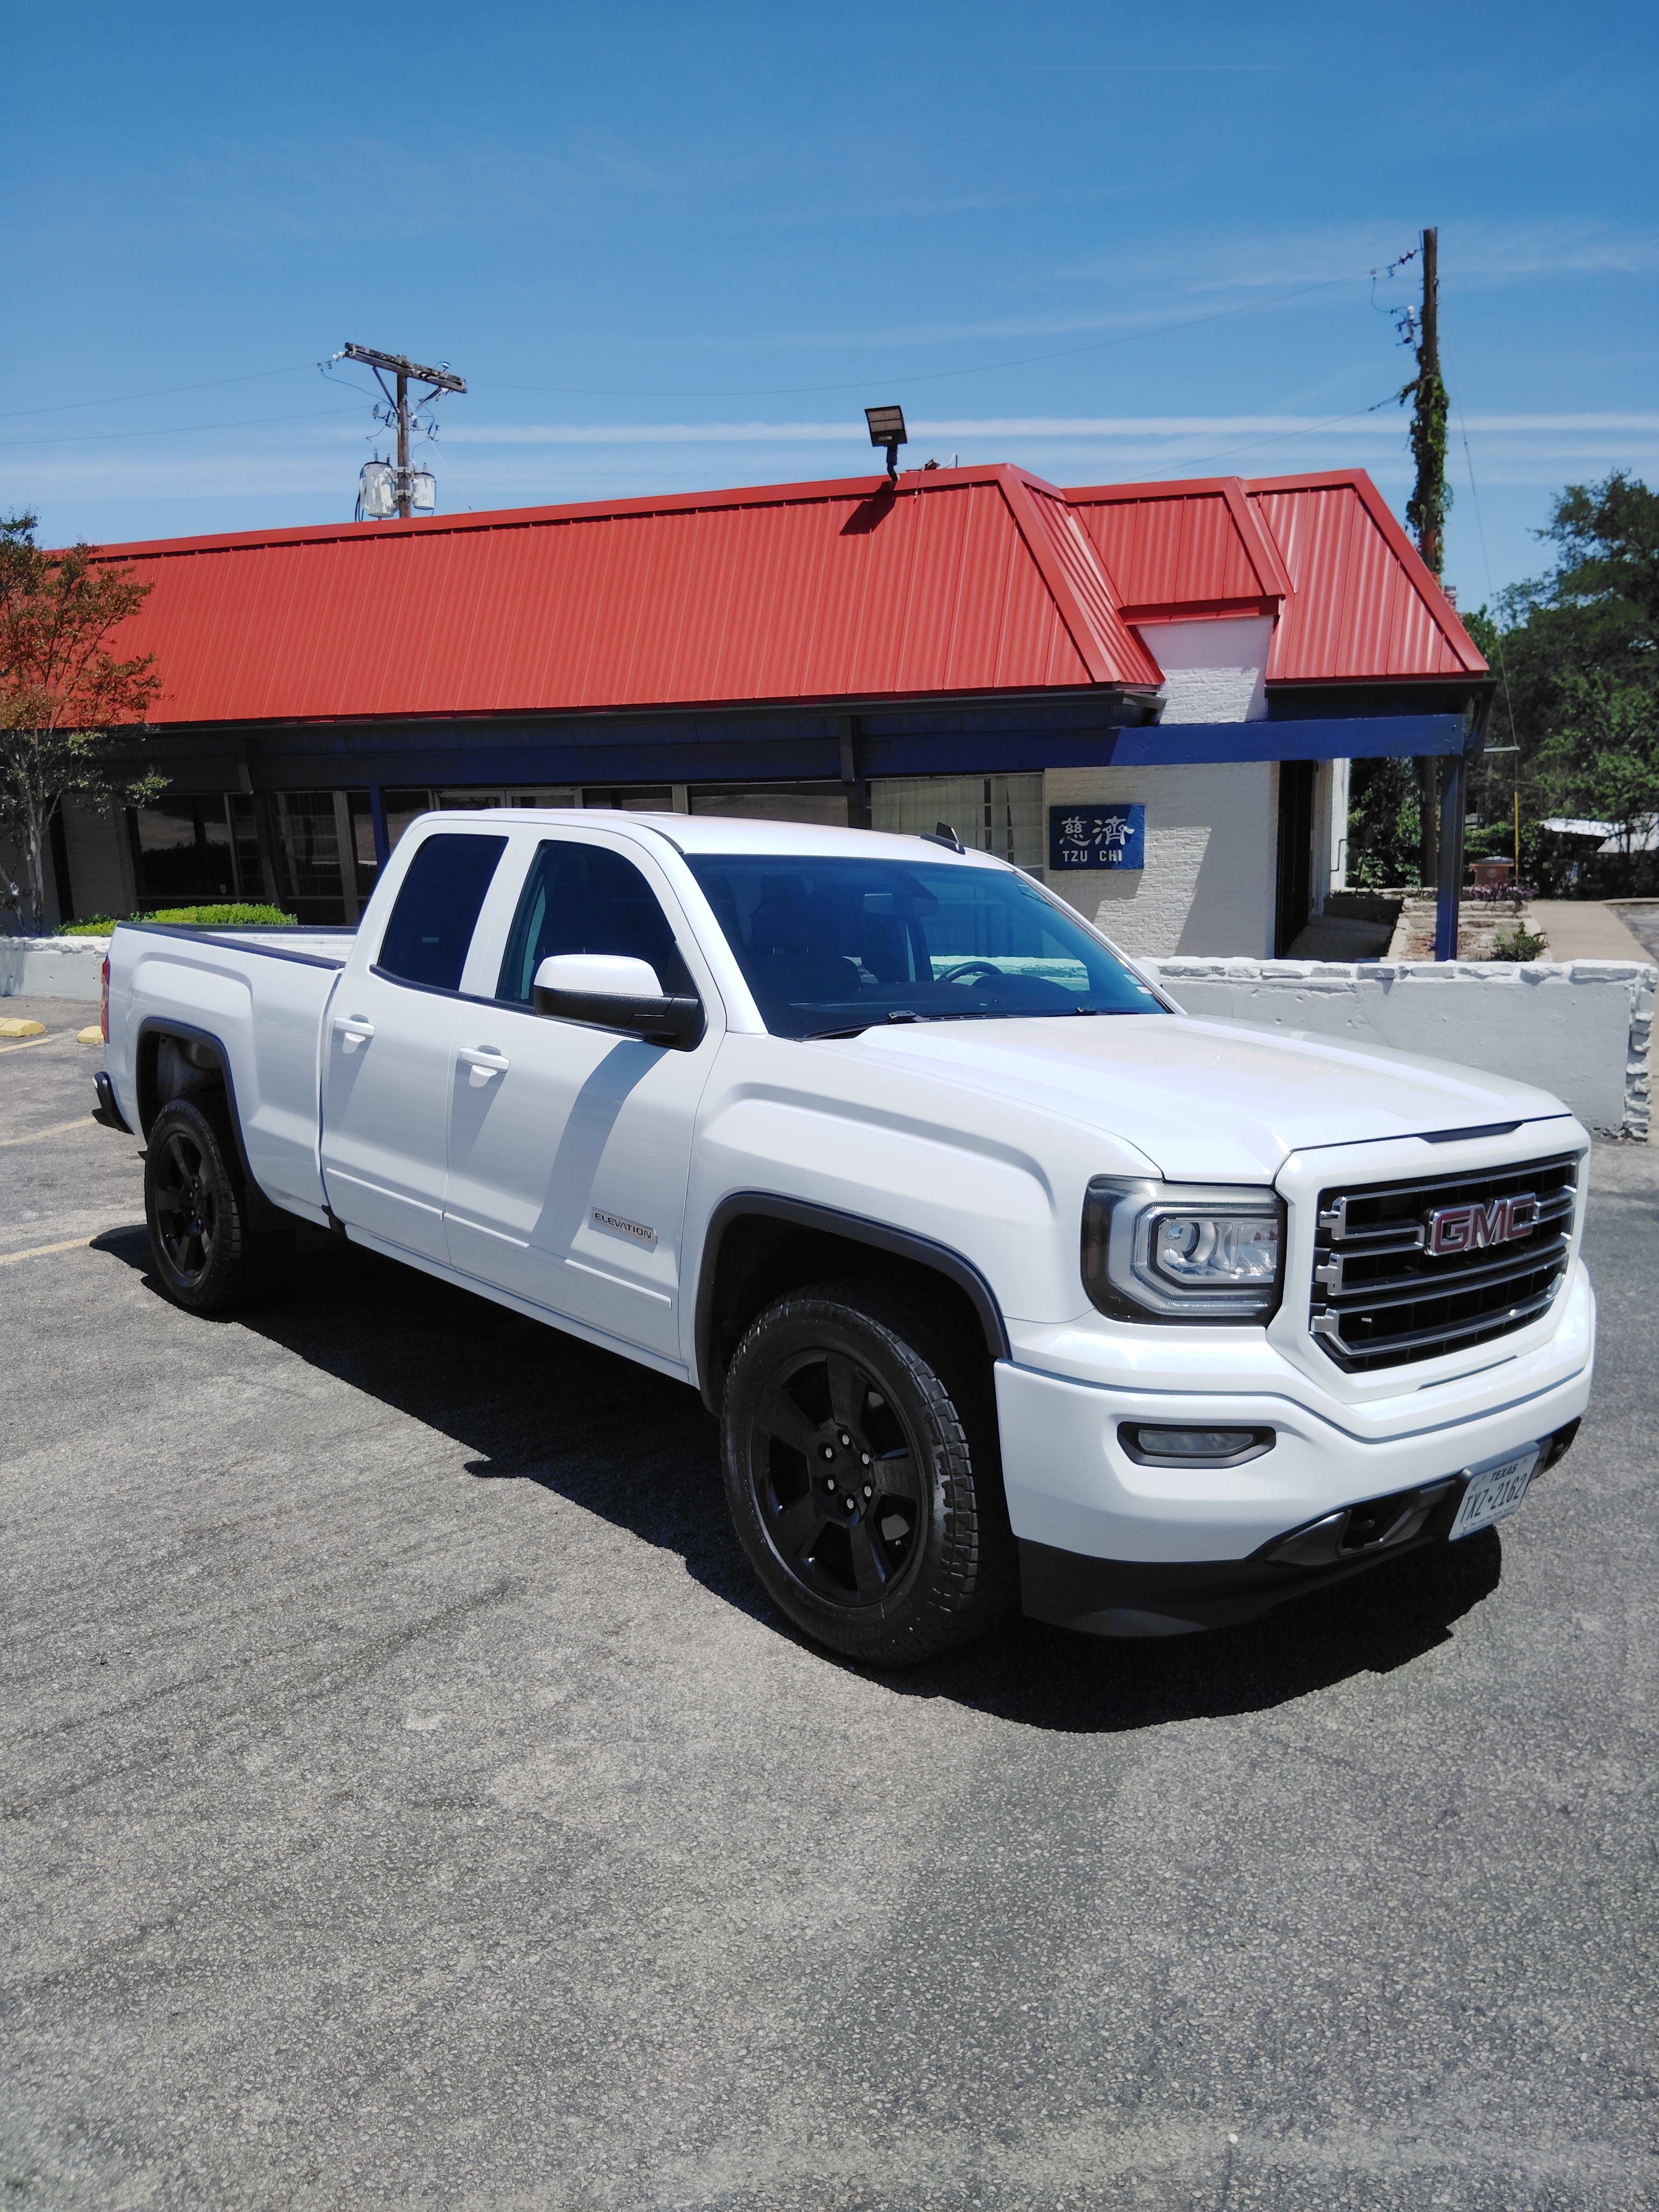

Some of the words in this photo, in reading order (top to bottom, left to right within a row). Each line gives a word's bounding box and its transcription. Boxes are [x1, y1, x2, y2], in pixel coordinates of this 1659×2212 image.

[1059, 815, 1134, 846] 慈濟
[1062, 850, 1088, 862] TZU
[1099, 850, 1123, 862] CHI
[595, 1212, 651, 1239] ELEVATION
[1428, 1192, 1539, 1256] GMC
[1491, 1463, 1518, 1482] TEXAS
